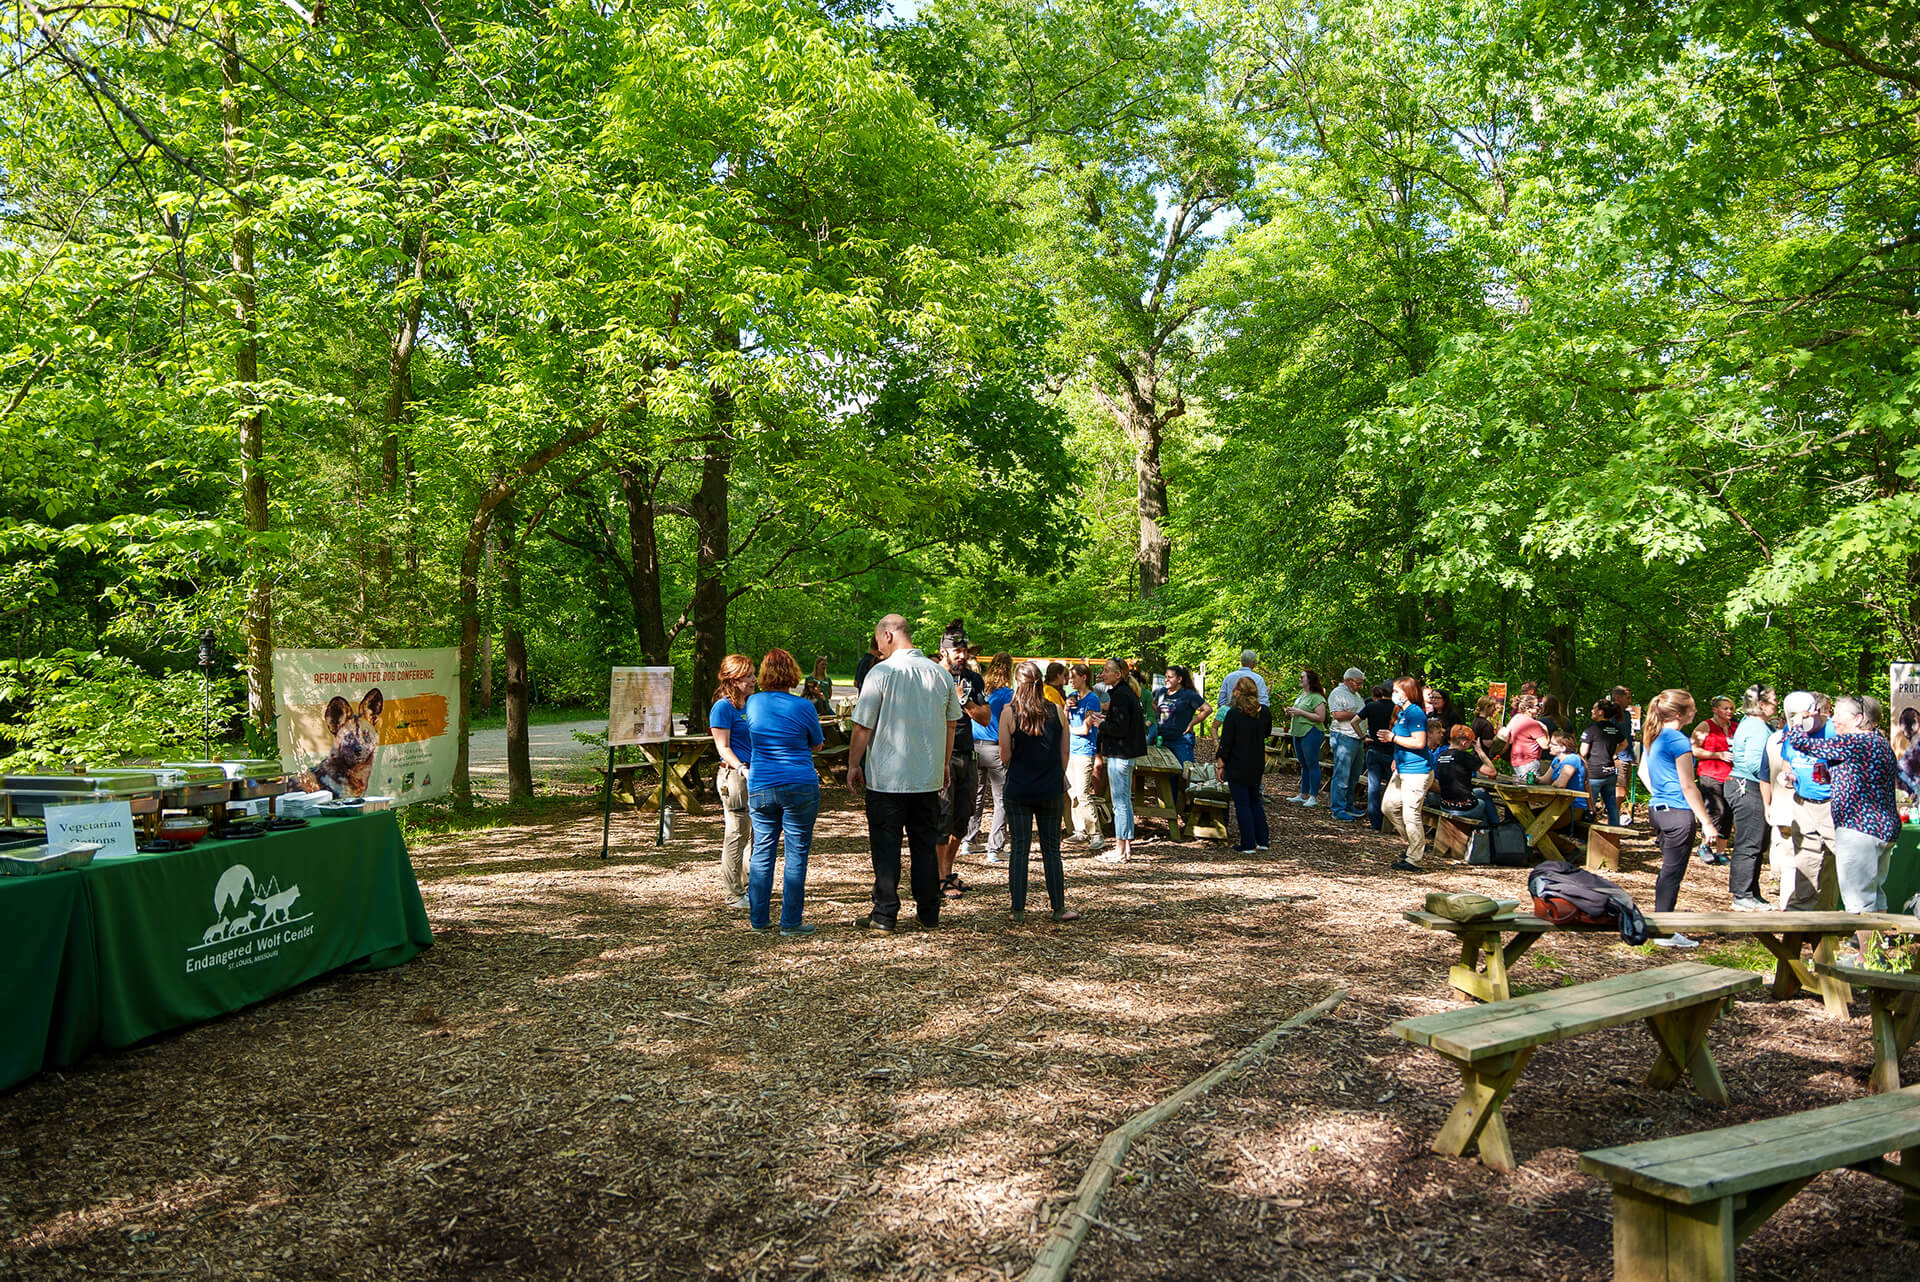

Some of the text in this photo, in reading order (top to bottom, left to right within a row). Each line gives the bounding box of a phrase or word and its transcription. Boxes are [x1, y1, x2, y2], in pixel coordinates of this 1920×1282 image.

[313, 669, 434, 684] AFRICAN PAINTED DOG CONFERENCE
[1898, 683, 1920, 693] PROT
[59, 820, 121, 834] Vegetarian
[70, 836, 116, 844] tions
[186, 924, 314, 973] Endangered Wolf Center
